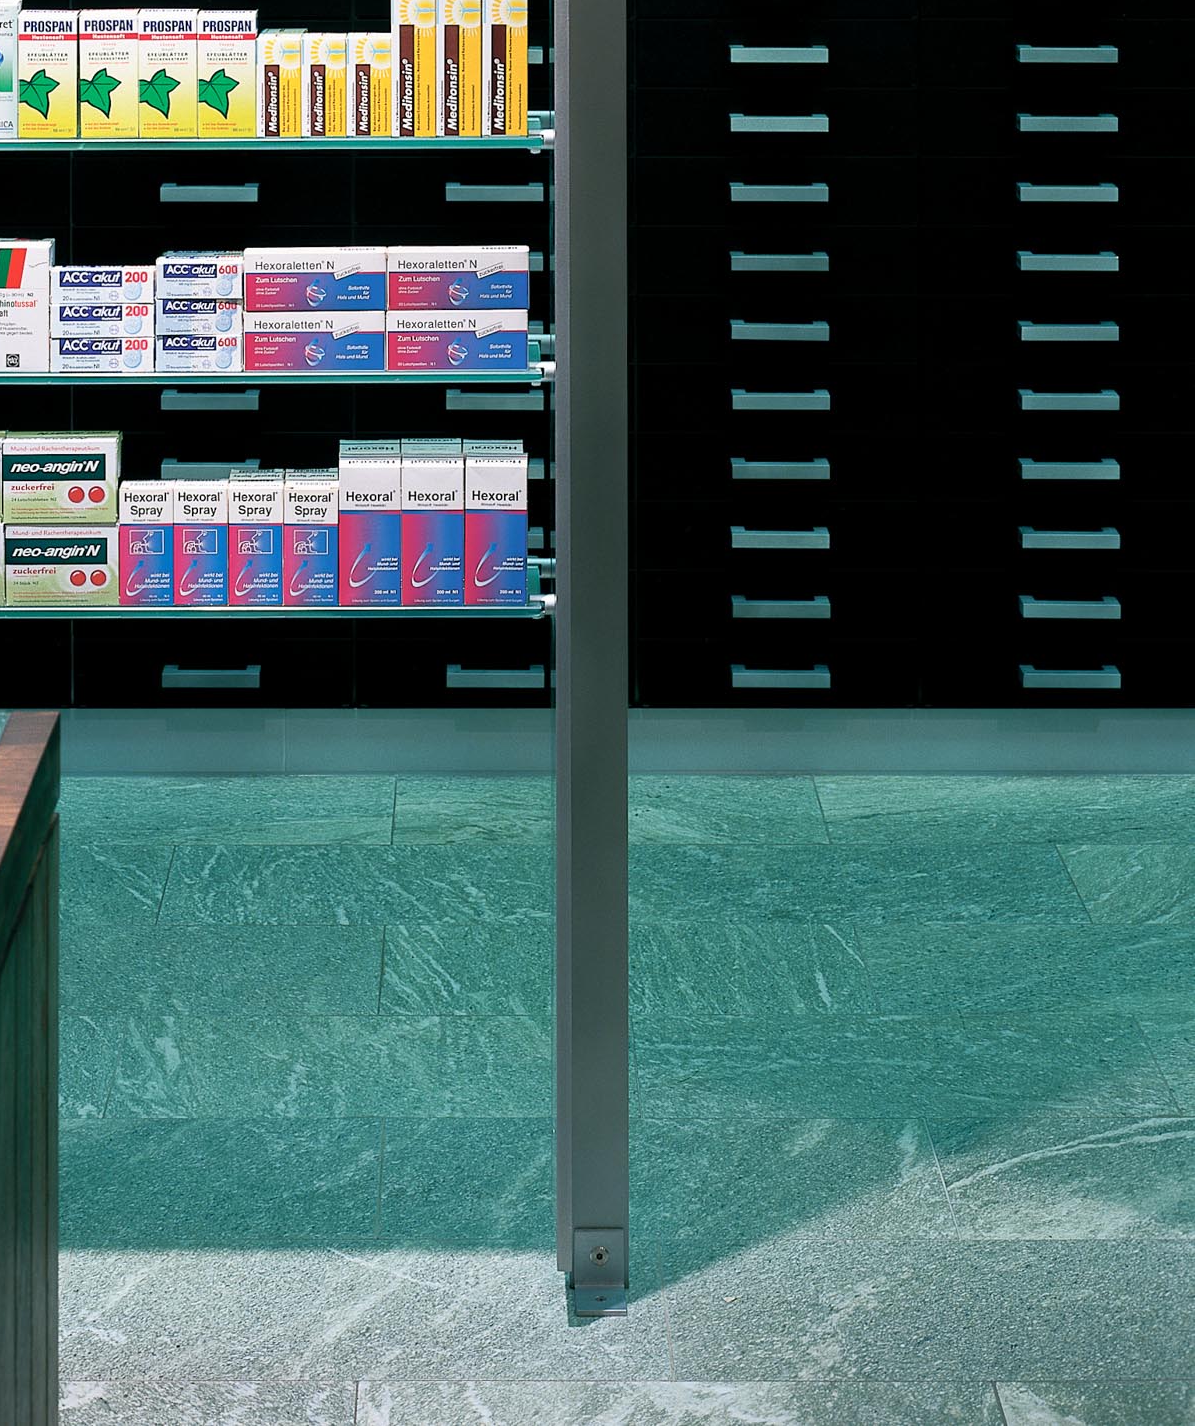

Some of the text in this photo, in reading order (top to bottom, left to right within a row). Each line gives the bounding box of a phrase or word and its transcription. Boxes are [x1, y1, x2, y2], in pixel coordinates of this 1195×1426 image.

[23, 21, 72, 32] PROSPAN
[84, 19, 133, 32] PROSPAN
[143, 20, 192, 32] PROSPAN
[203, 21, 251, 32] PROSPAN
[402, 63, 413, 130] Meditonsin
[447, 63, 458, 130] Meditonsin
[494, 63, 505, 130] Meditonsin
[268, 76, 278, 133] Meditonsin
[314, 76, 324, 132] Meditonsin
[398, 260, 477, 269] Hexoraletten N
[166, 266, 238, 275] ACC akut 600
[62, 272, 147, 283] ACC akut 200
[397, 319, 476, 329] Hexoraletten N
[62, 340, 148, 351] ACC akut 200
[11, 483, 55, 491] zuckerfrei
[124, 493, 167, 502] Hexoral
[233, 492, 276, 502] Hexoral
[346, 492, 393, 502] Hexoral
[408, 492, 455, 501] Hexoral
[472, 491, 519, 501] Hexoral
[130, 506, 163, 517] Spray
[238, 506, 272, 516] Spray
